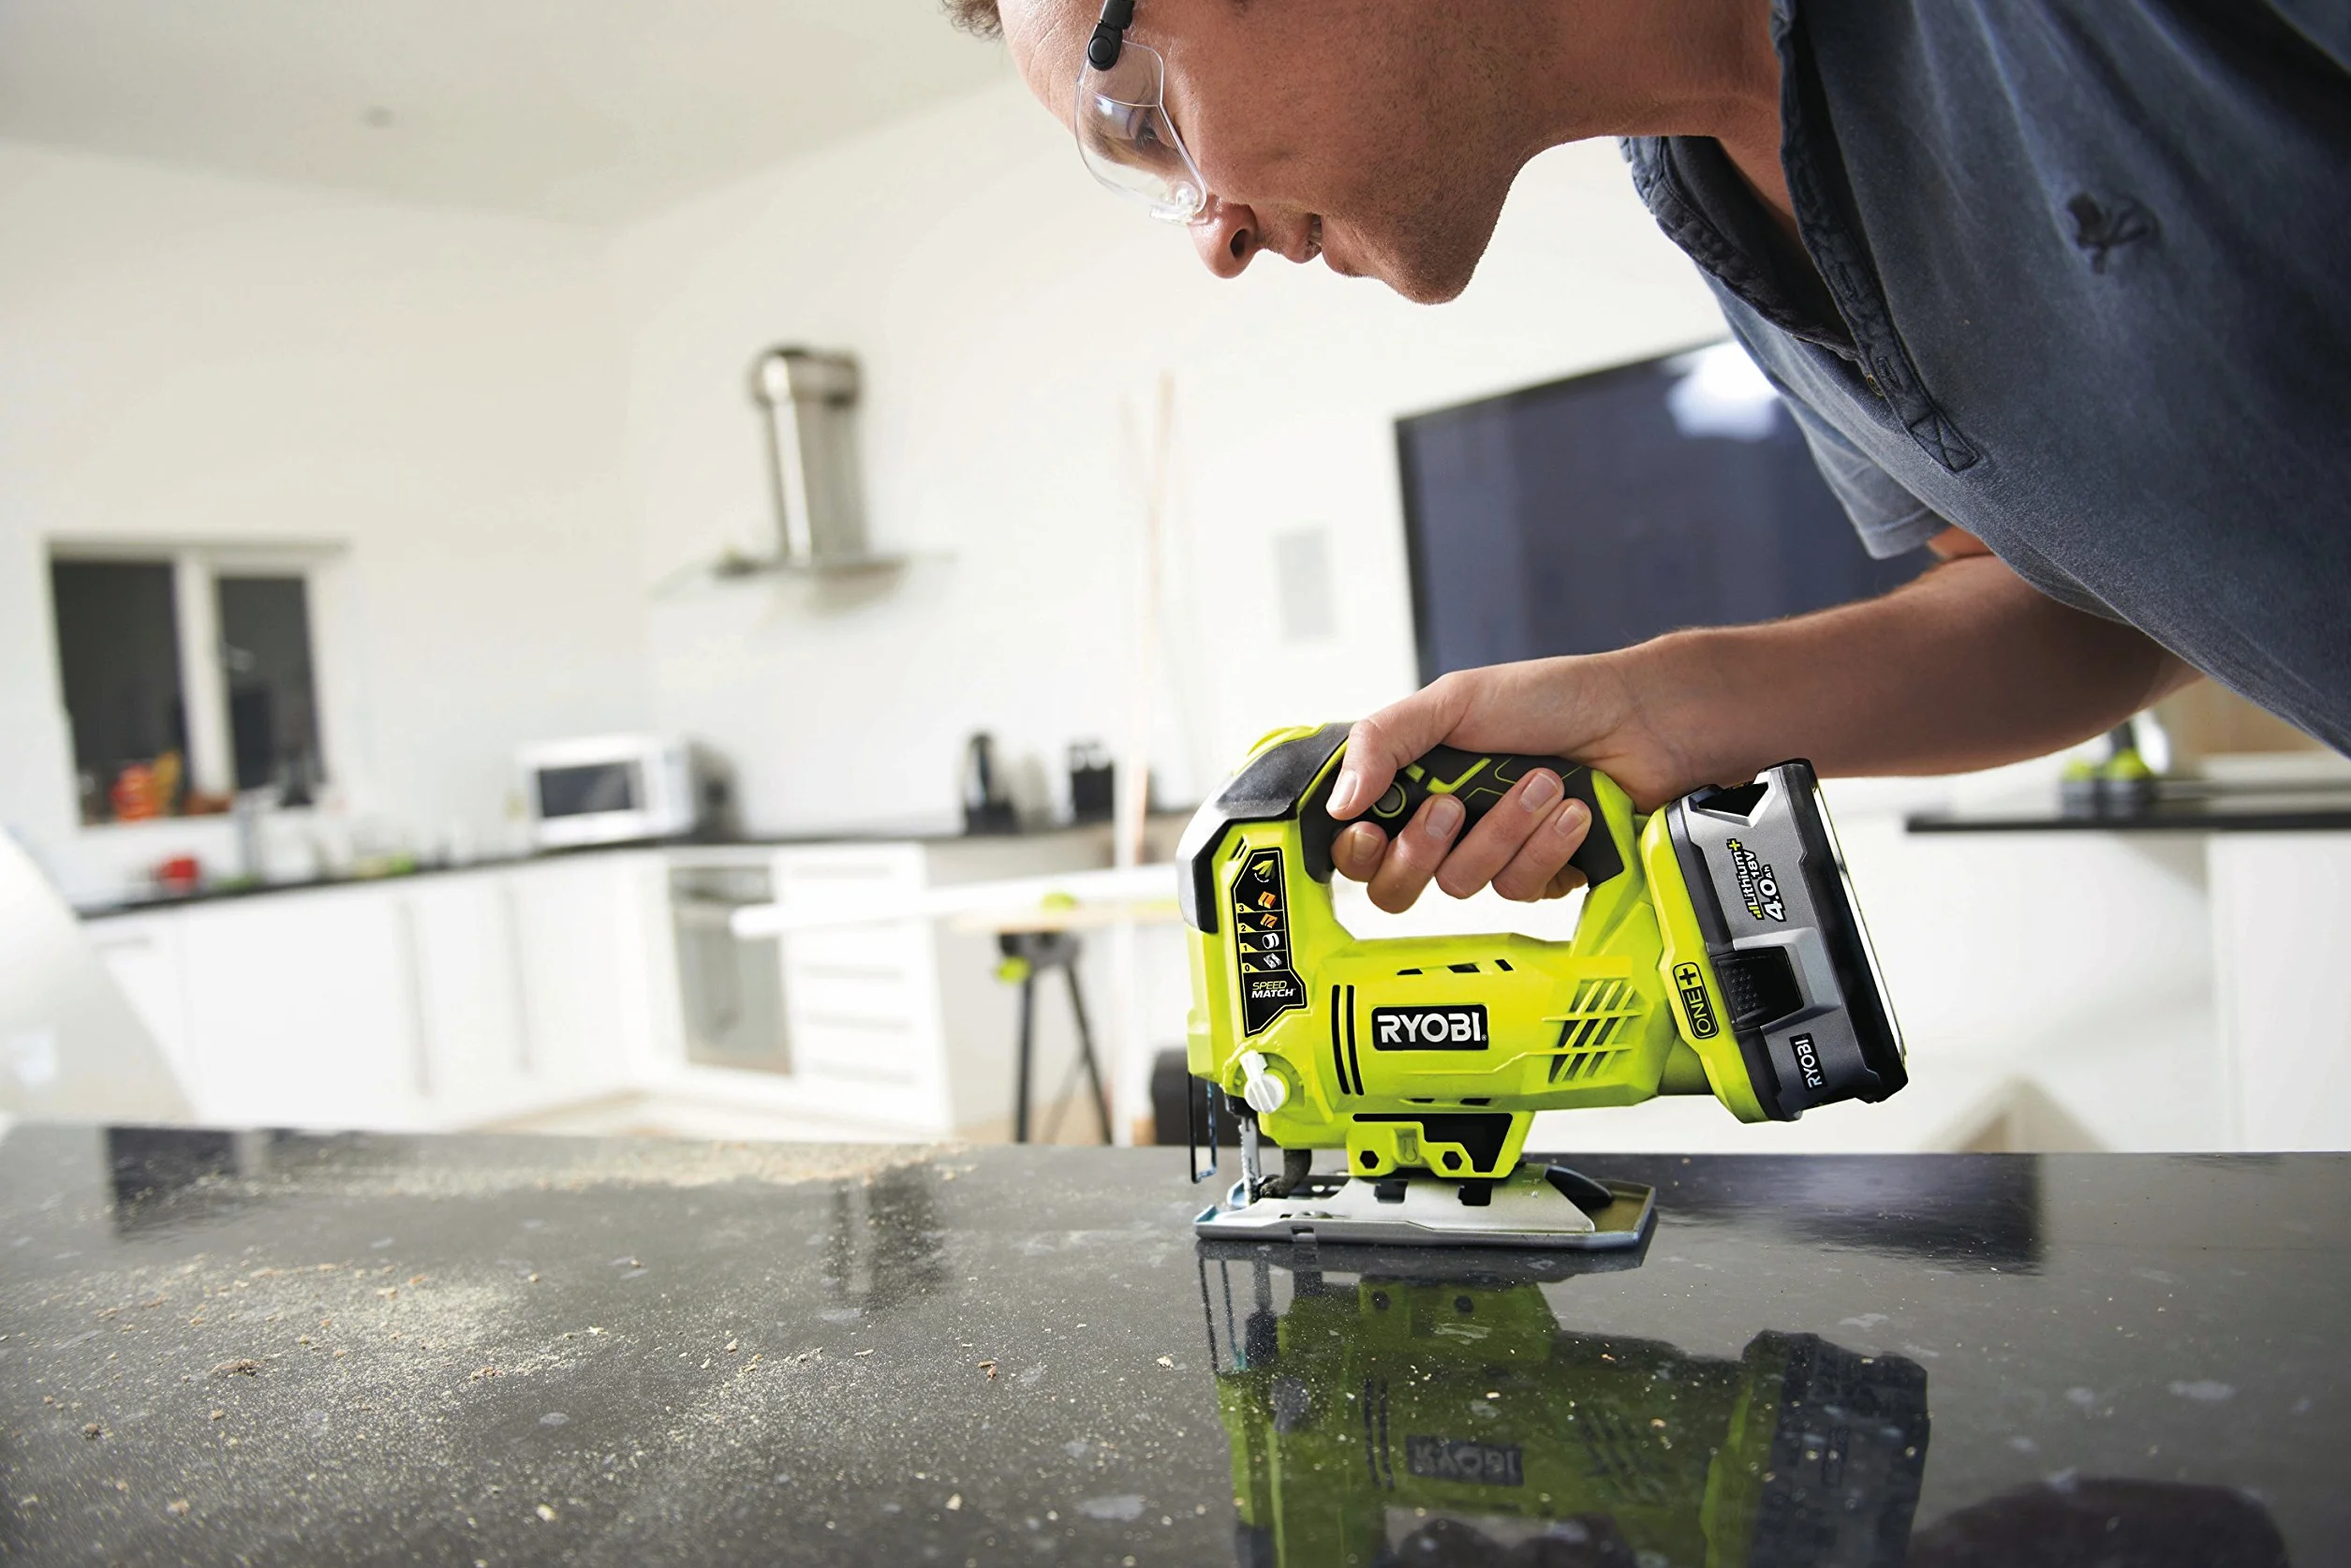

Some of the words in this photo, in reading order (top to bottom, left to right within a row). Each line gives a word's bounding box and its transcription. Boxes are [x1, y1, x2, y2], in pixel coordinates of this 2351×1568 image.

[1743, 851, 1760, 878] 18V
[1251, 989, 1294, 998] MATCH
[1252, 981, 1287, 990] SPEED
[1377, 1012, 1481, 1043] RYOBI
[1794, 1038, 1823, 1088] RYOBI
